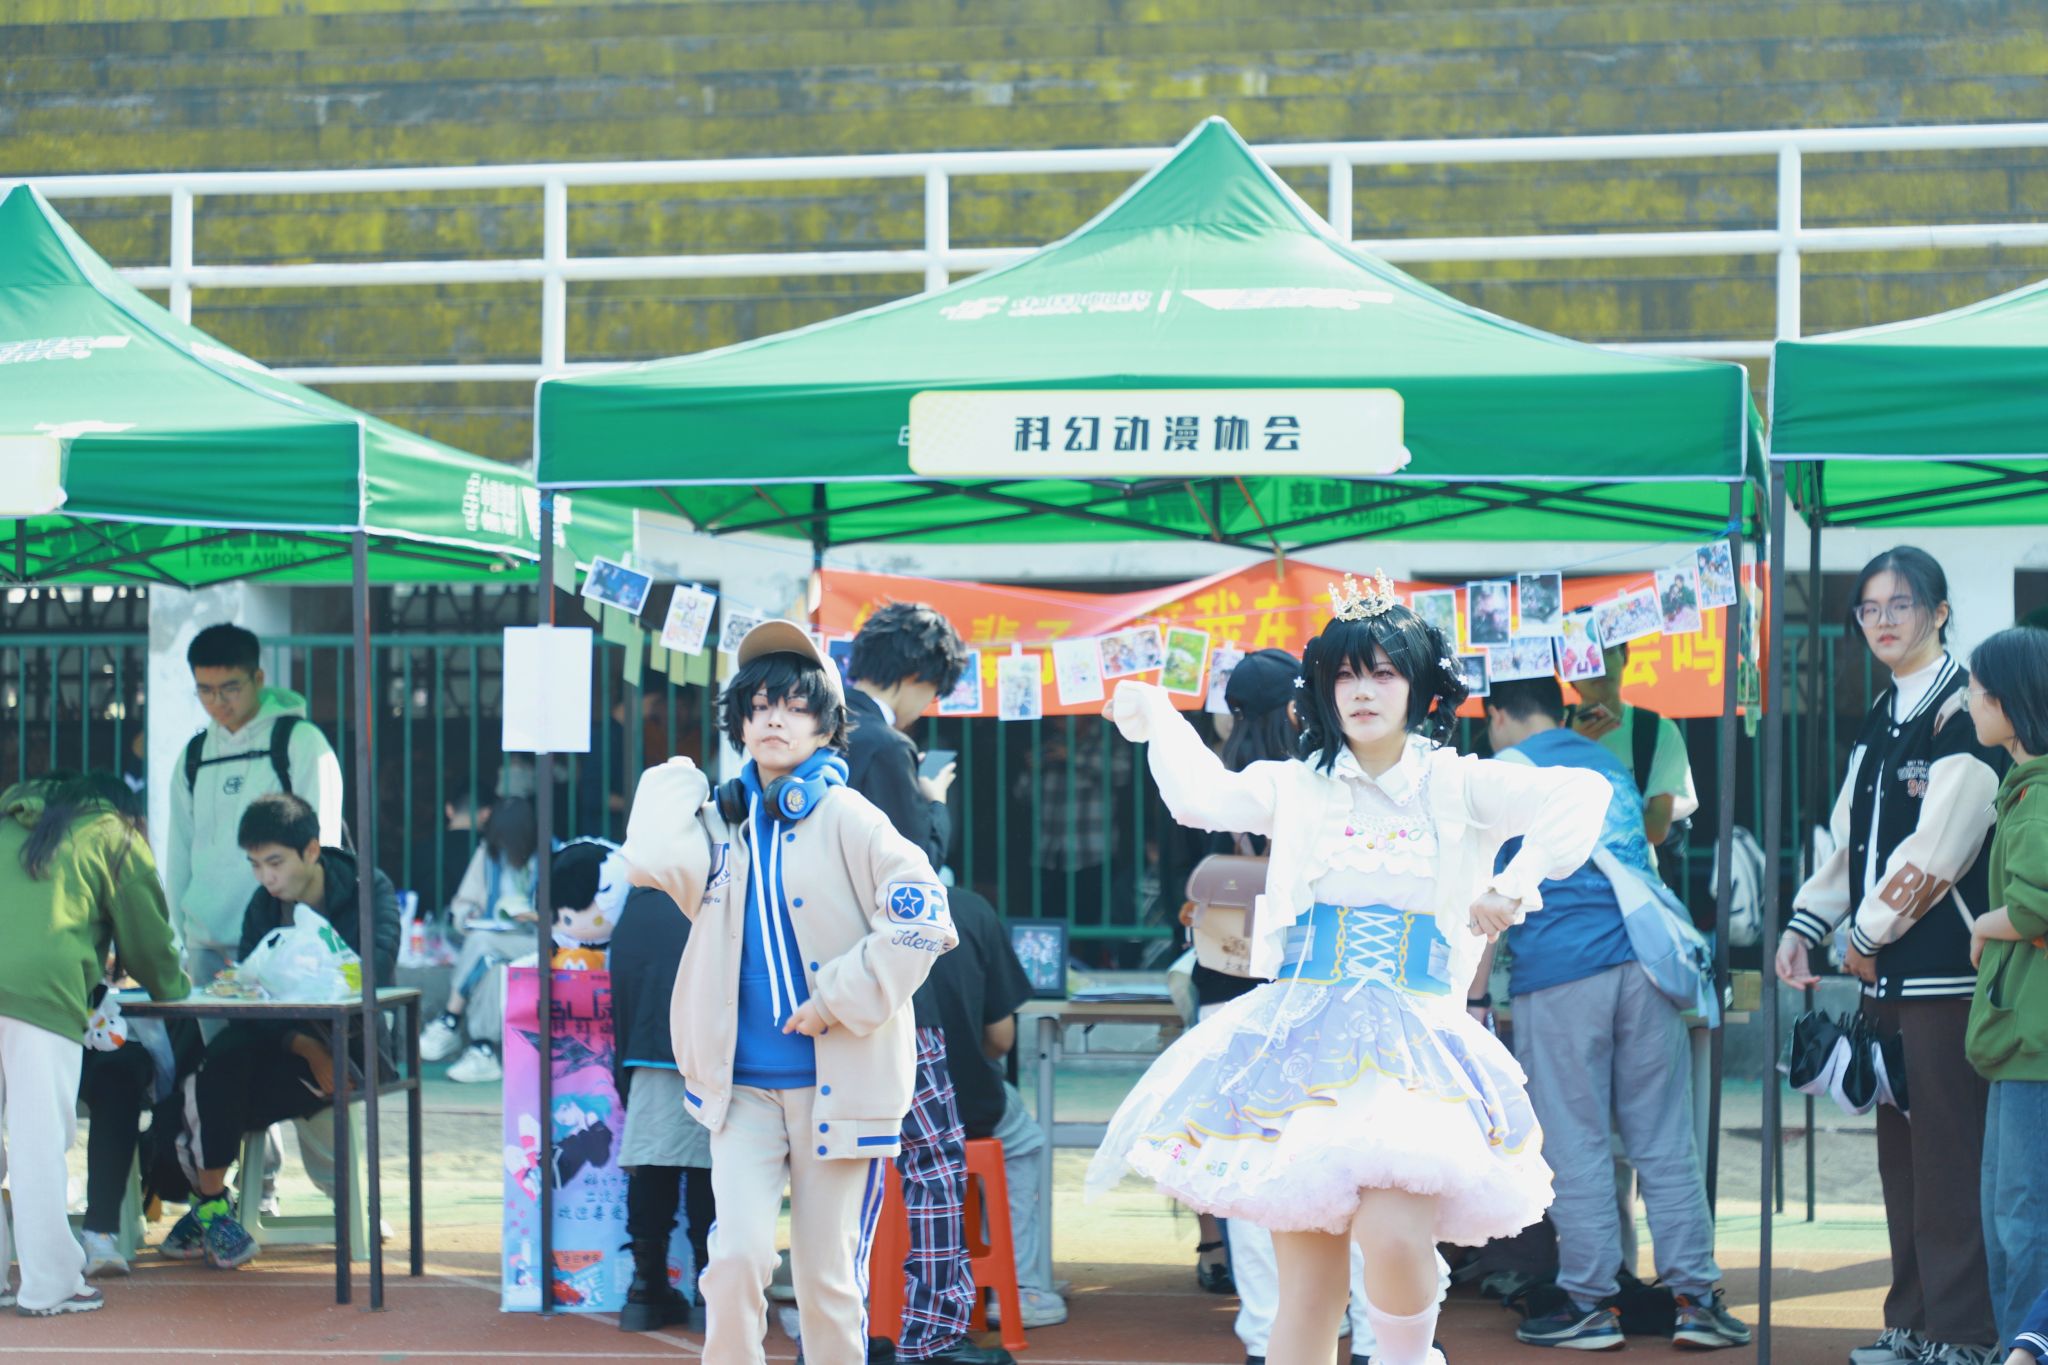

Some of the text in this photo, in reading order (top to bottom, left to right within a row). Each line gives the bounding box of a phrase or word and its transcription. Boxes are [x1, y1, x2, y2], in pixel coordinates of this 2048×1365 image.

[1014, 415, 1301, 451] 科幻动漫协会
